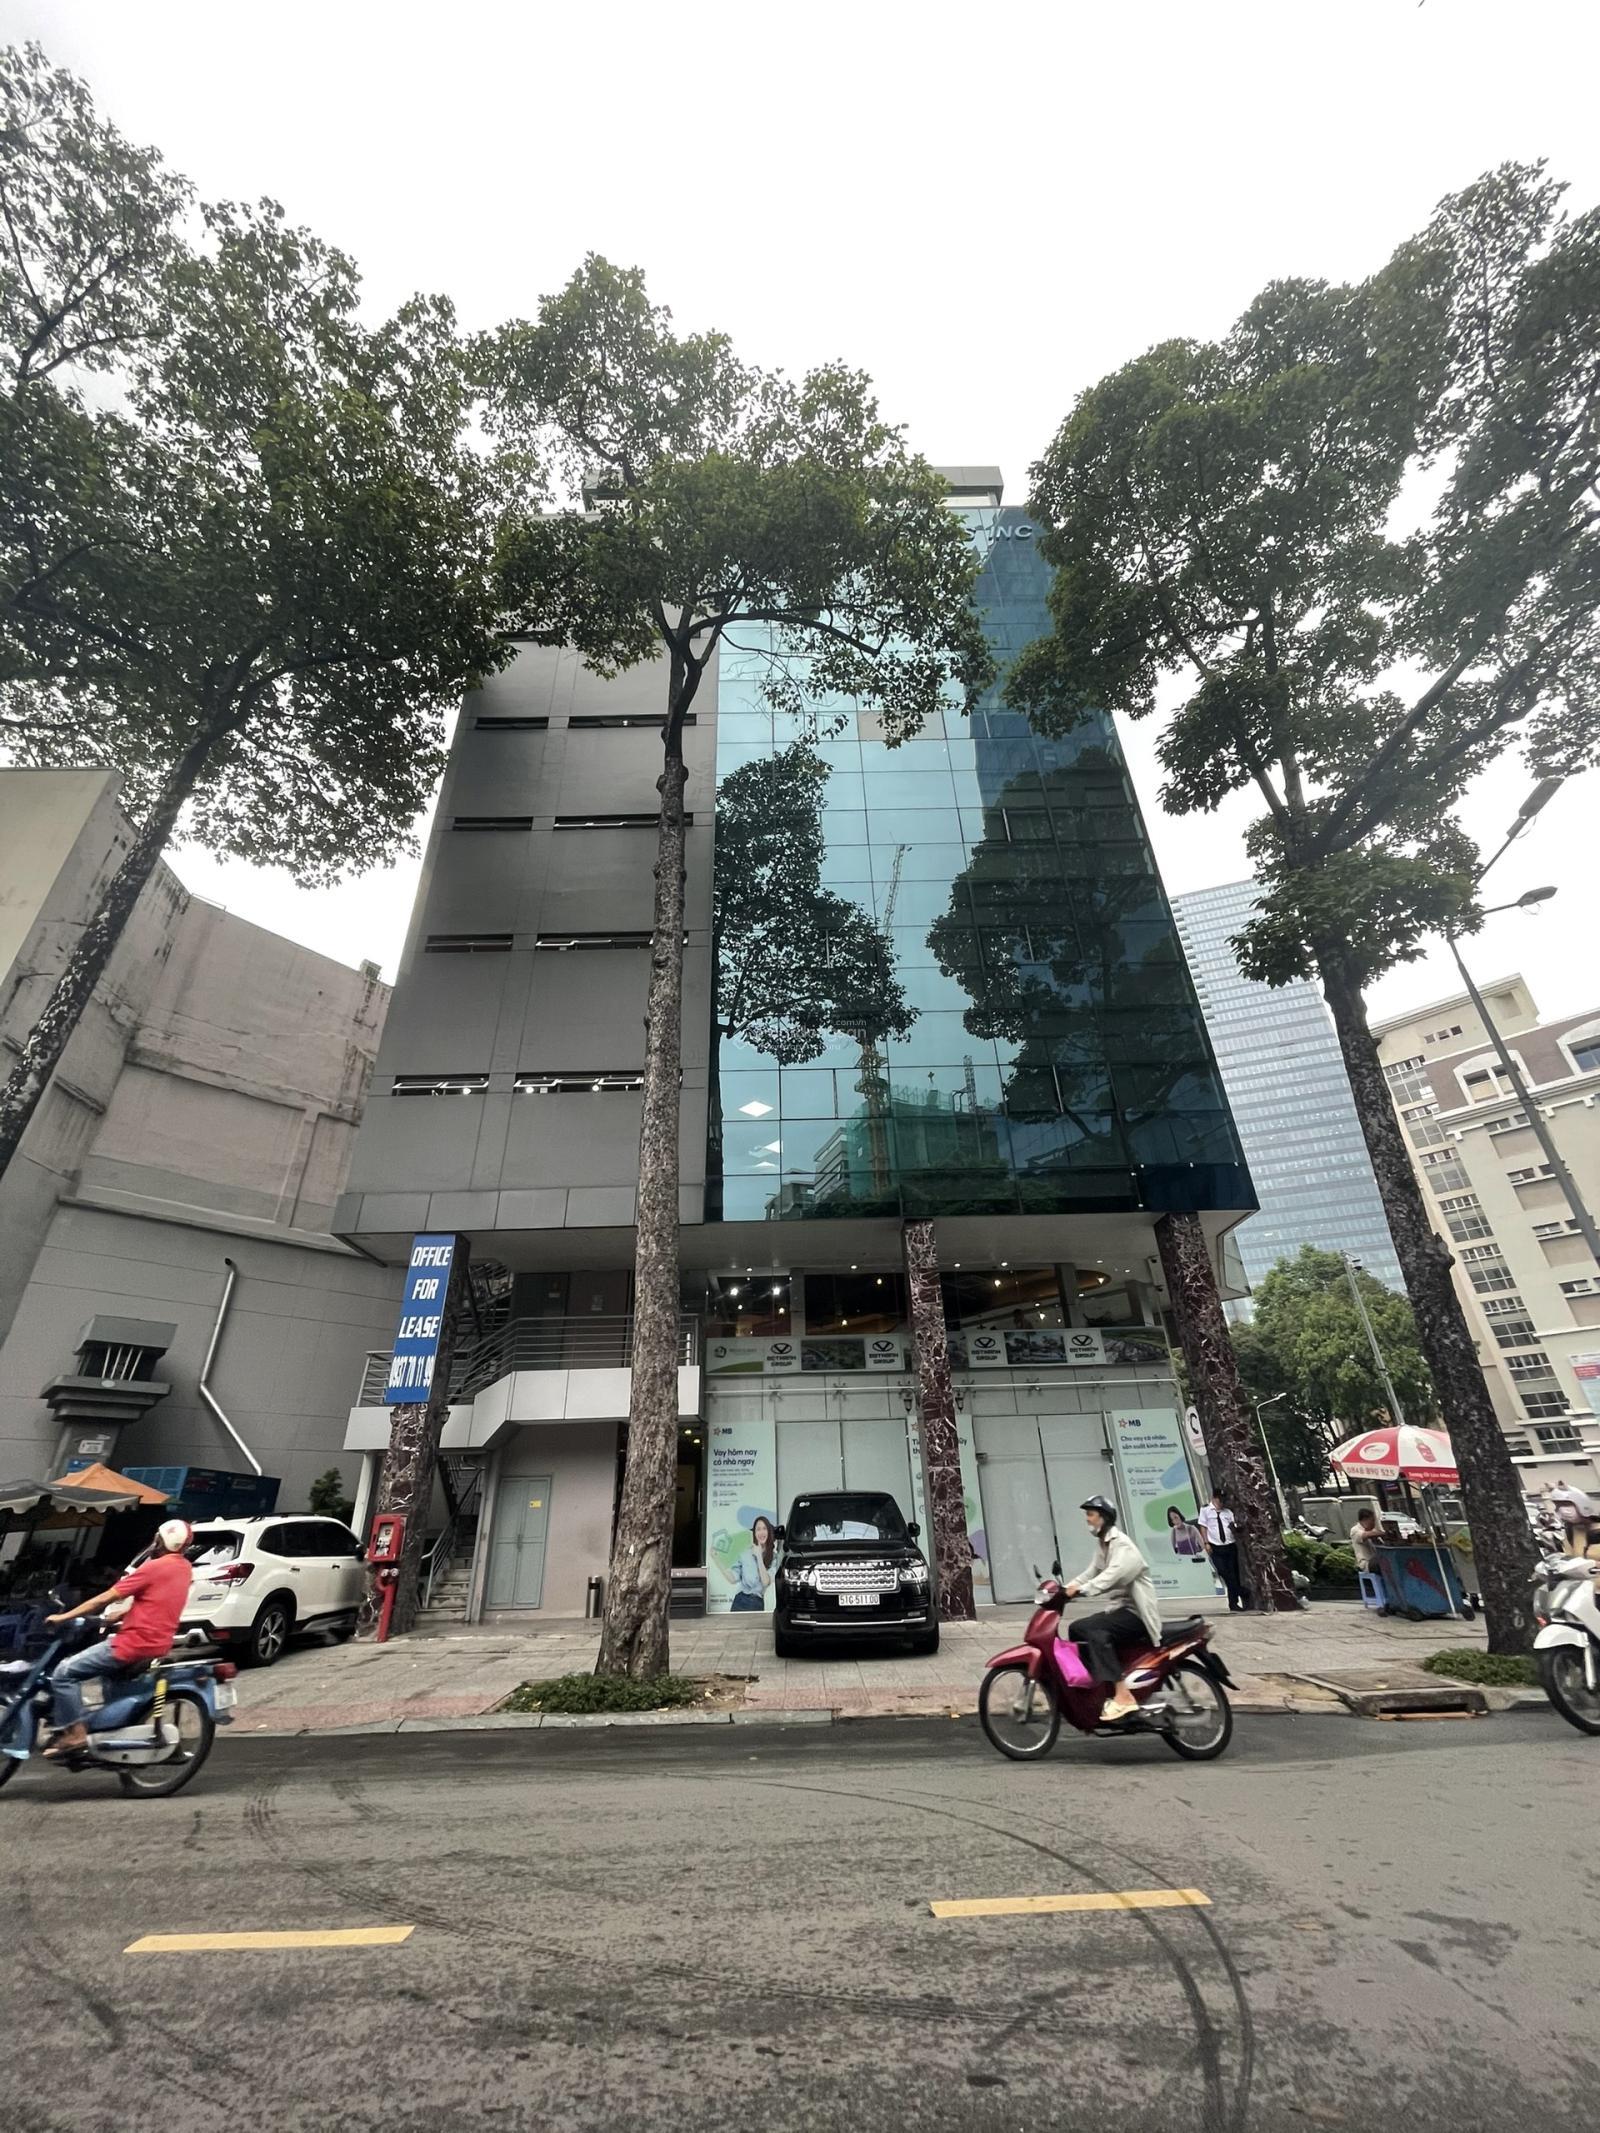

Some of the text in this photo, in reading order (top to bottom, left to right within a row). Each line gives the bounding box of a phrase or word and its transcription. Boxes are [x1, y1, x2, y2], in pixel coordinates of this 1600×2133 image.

[989, 525, 1033, 540] INC
[411, 1246, 452, 1267] OFFICE
[412, 1279, 439, 1300] FOR
[399, 1316, 440, 1338] LEASE
[415, 1356, 425, 1387] 11
[721, 1427, 733, 1435] MB
[1128, 1419, 1142, 1427] MB
[713, 1448, 757, 1457] Vay hôm nay
